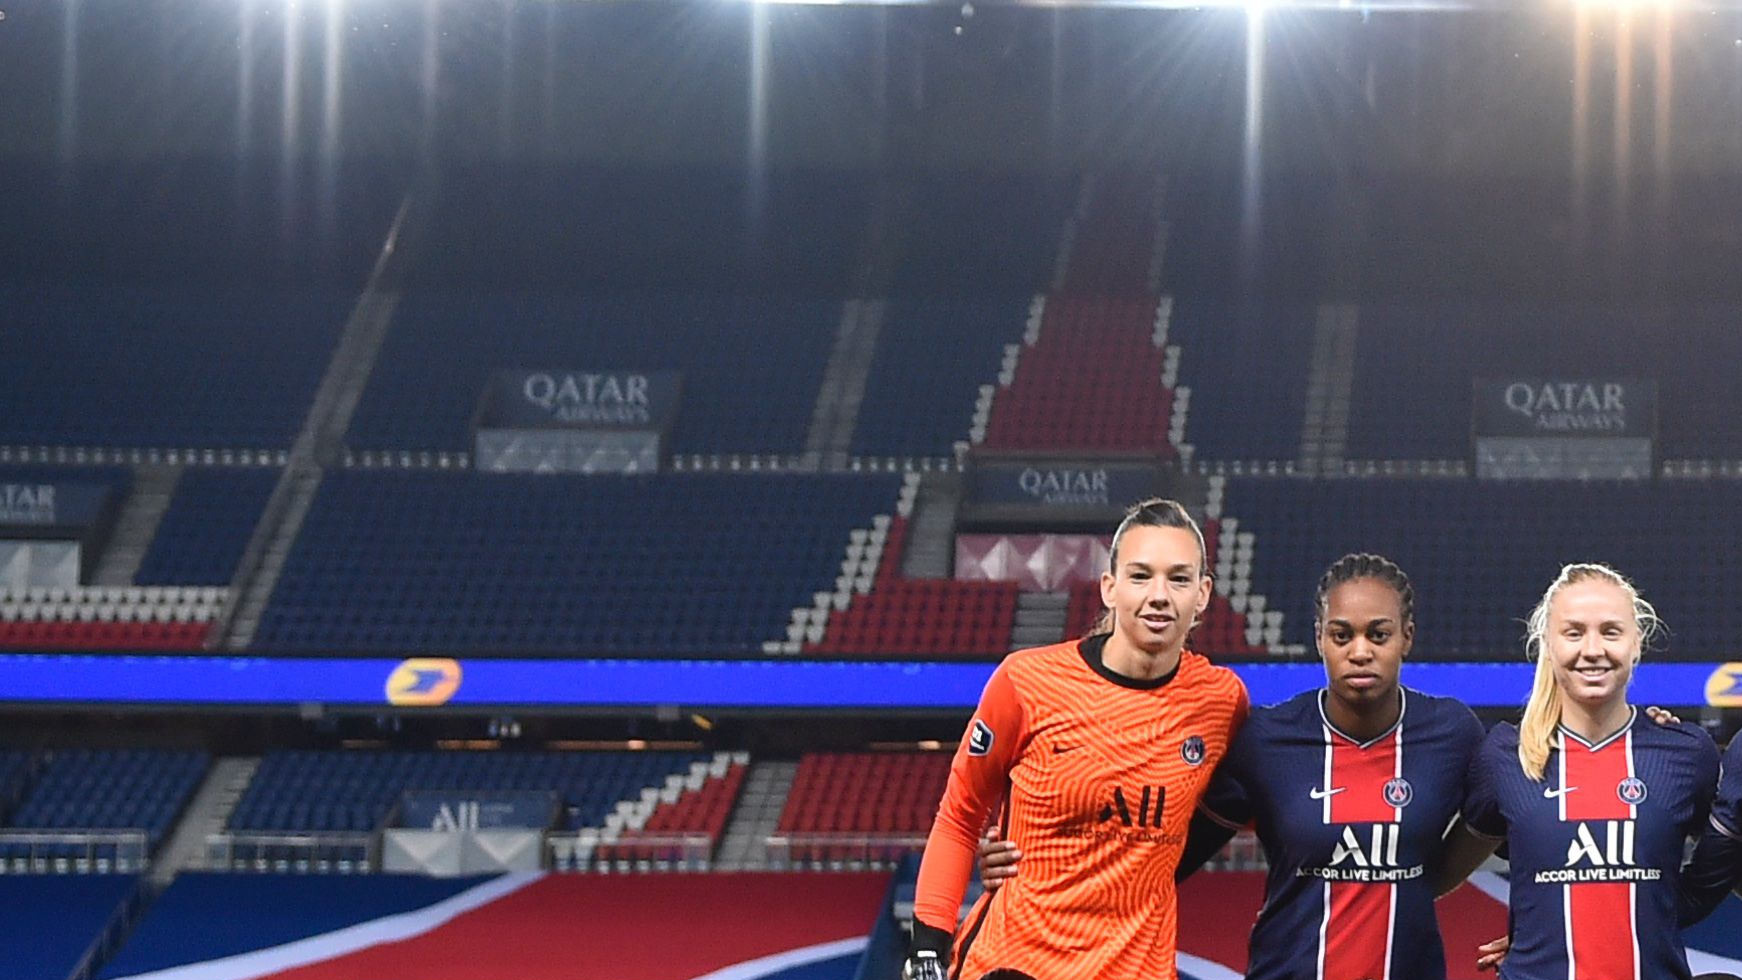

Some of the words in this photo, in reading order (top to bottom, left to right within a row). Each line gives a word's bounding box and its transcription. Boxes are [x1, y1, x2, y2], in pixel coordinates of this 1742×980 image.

[523, 373, 650, 408] QATAR
[1504, 382, 1625, 417] QATAR
[1020, 468, 1108, 495] QATAR
[0, 484, 55, 507] TAR
[1296, 867, 1339, 879] ACCOR
[1342, 869, 1370, 881] LIVE
[1372, 864, 1423, 880] LIMITLESS
[1535, 869, 1577, 883] ACCOR
[1578, 868, 1607, 880] LIVE
[1609, 868, 1661, 880] LIMITLESS
